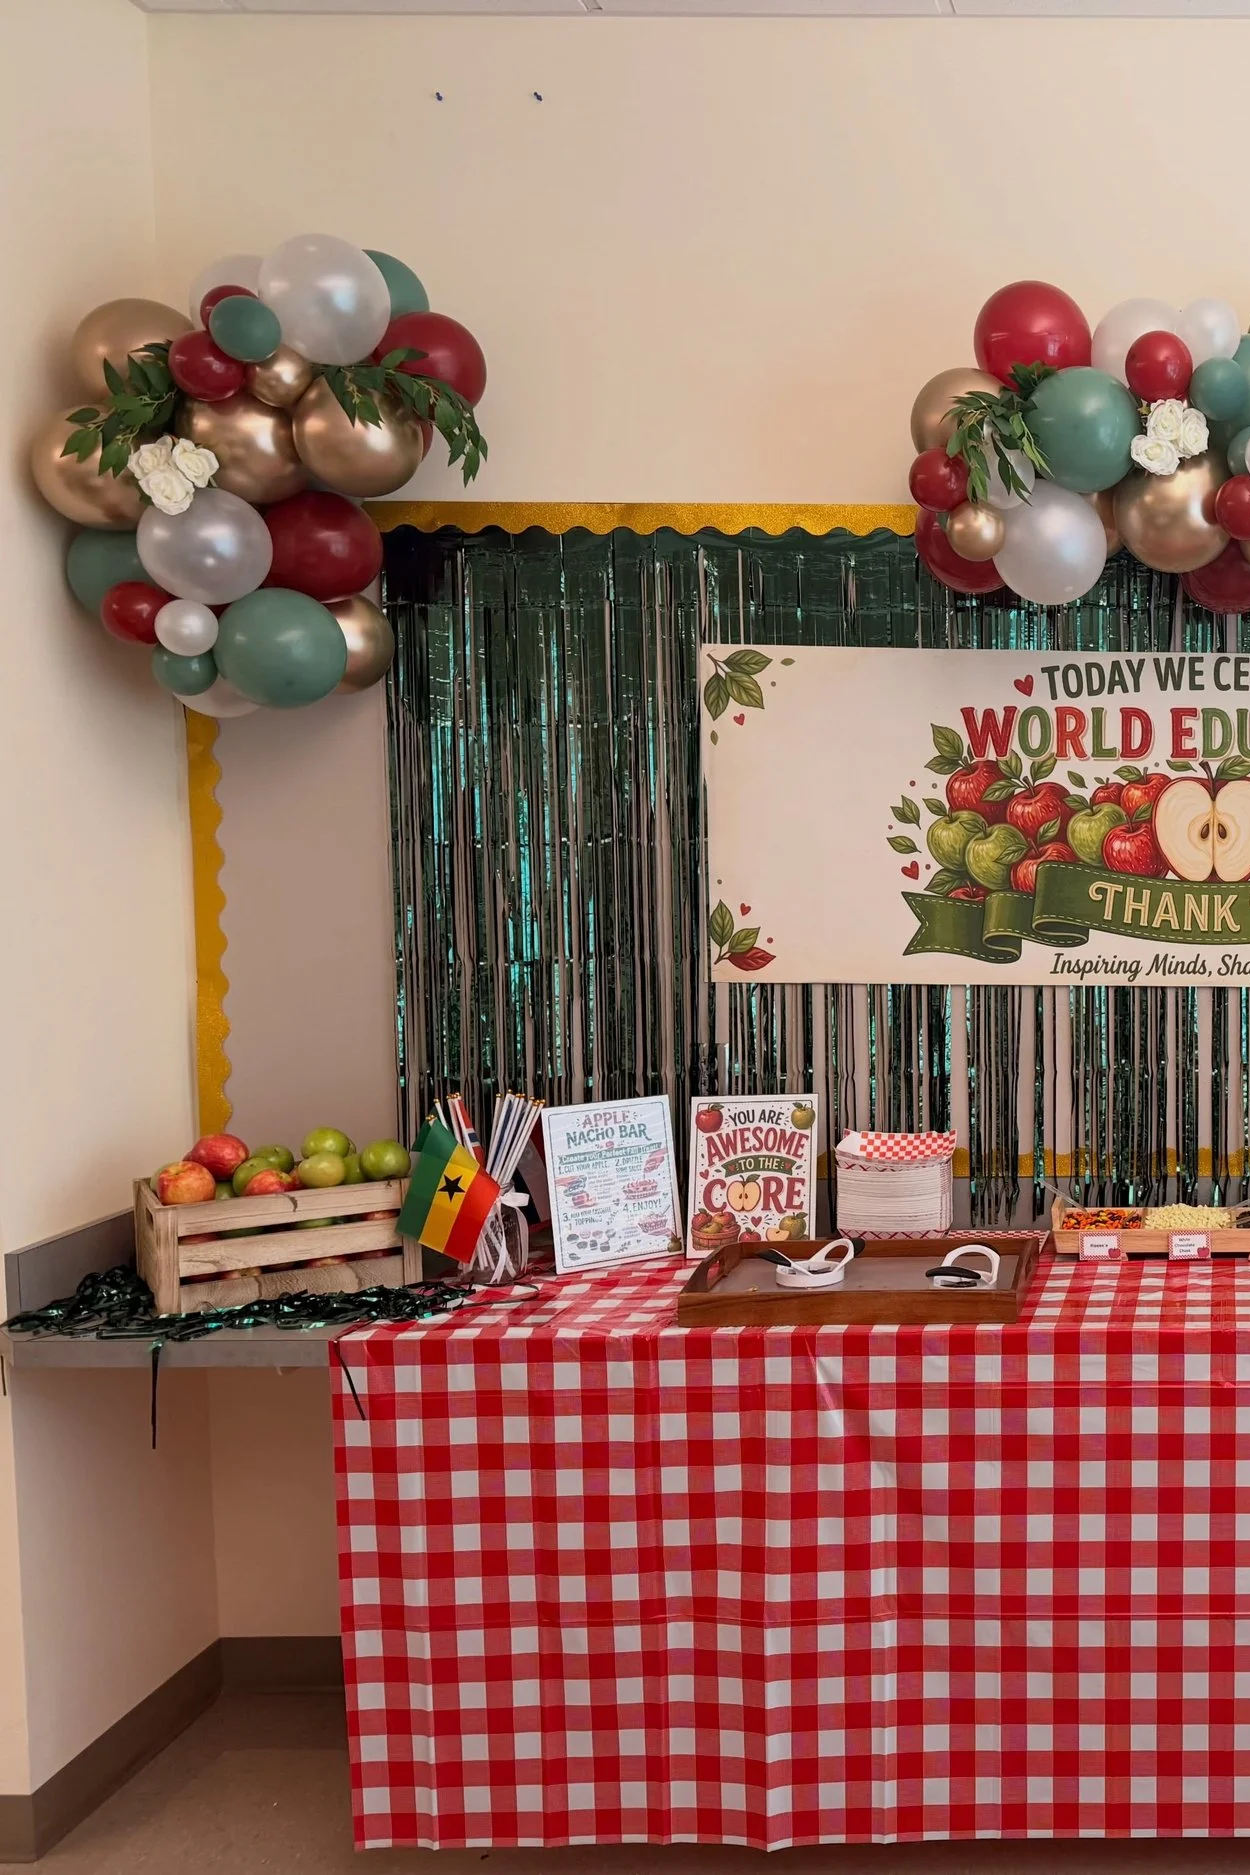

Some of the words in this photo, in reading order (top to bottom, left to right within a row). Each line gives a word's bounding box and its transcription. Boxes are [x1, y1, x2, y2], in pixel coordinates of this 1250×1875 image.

[1041, 658, 1146, 700] TODAY
[1153, 656, 1205, 692] WE
[960, 705, 1155, 761] WORLD
[1088, 881, 1241, 933] THANK
[1050, 952, 1142, 982] Inspiring
[1145, 953, 1213, 978] Minds,
[582, 1110, 631, 1129] APPLE
[728, 1109, 755, 1127] YOU
[758, 1109, 785, 1126] ARE
[566, 1127, 615, 1149] NACHO
[619, 1123, 652, 1141] BAR
[705, 1125, 810, 1167] AWESOME
[738, 1159, 754, 1171] TO
[757, 1157, 780, 1170] THE
[622, 1203, 632, 1213] 4.
[632, 1198, 662, 1212] ENJOY!
